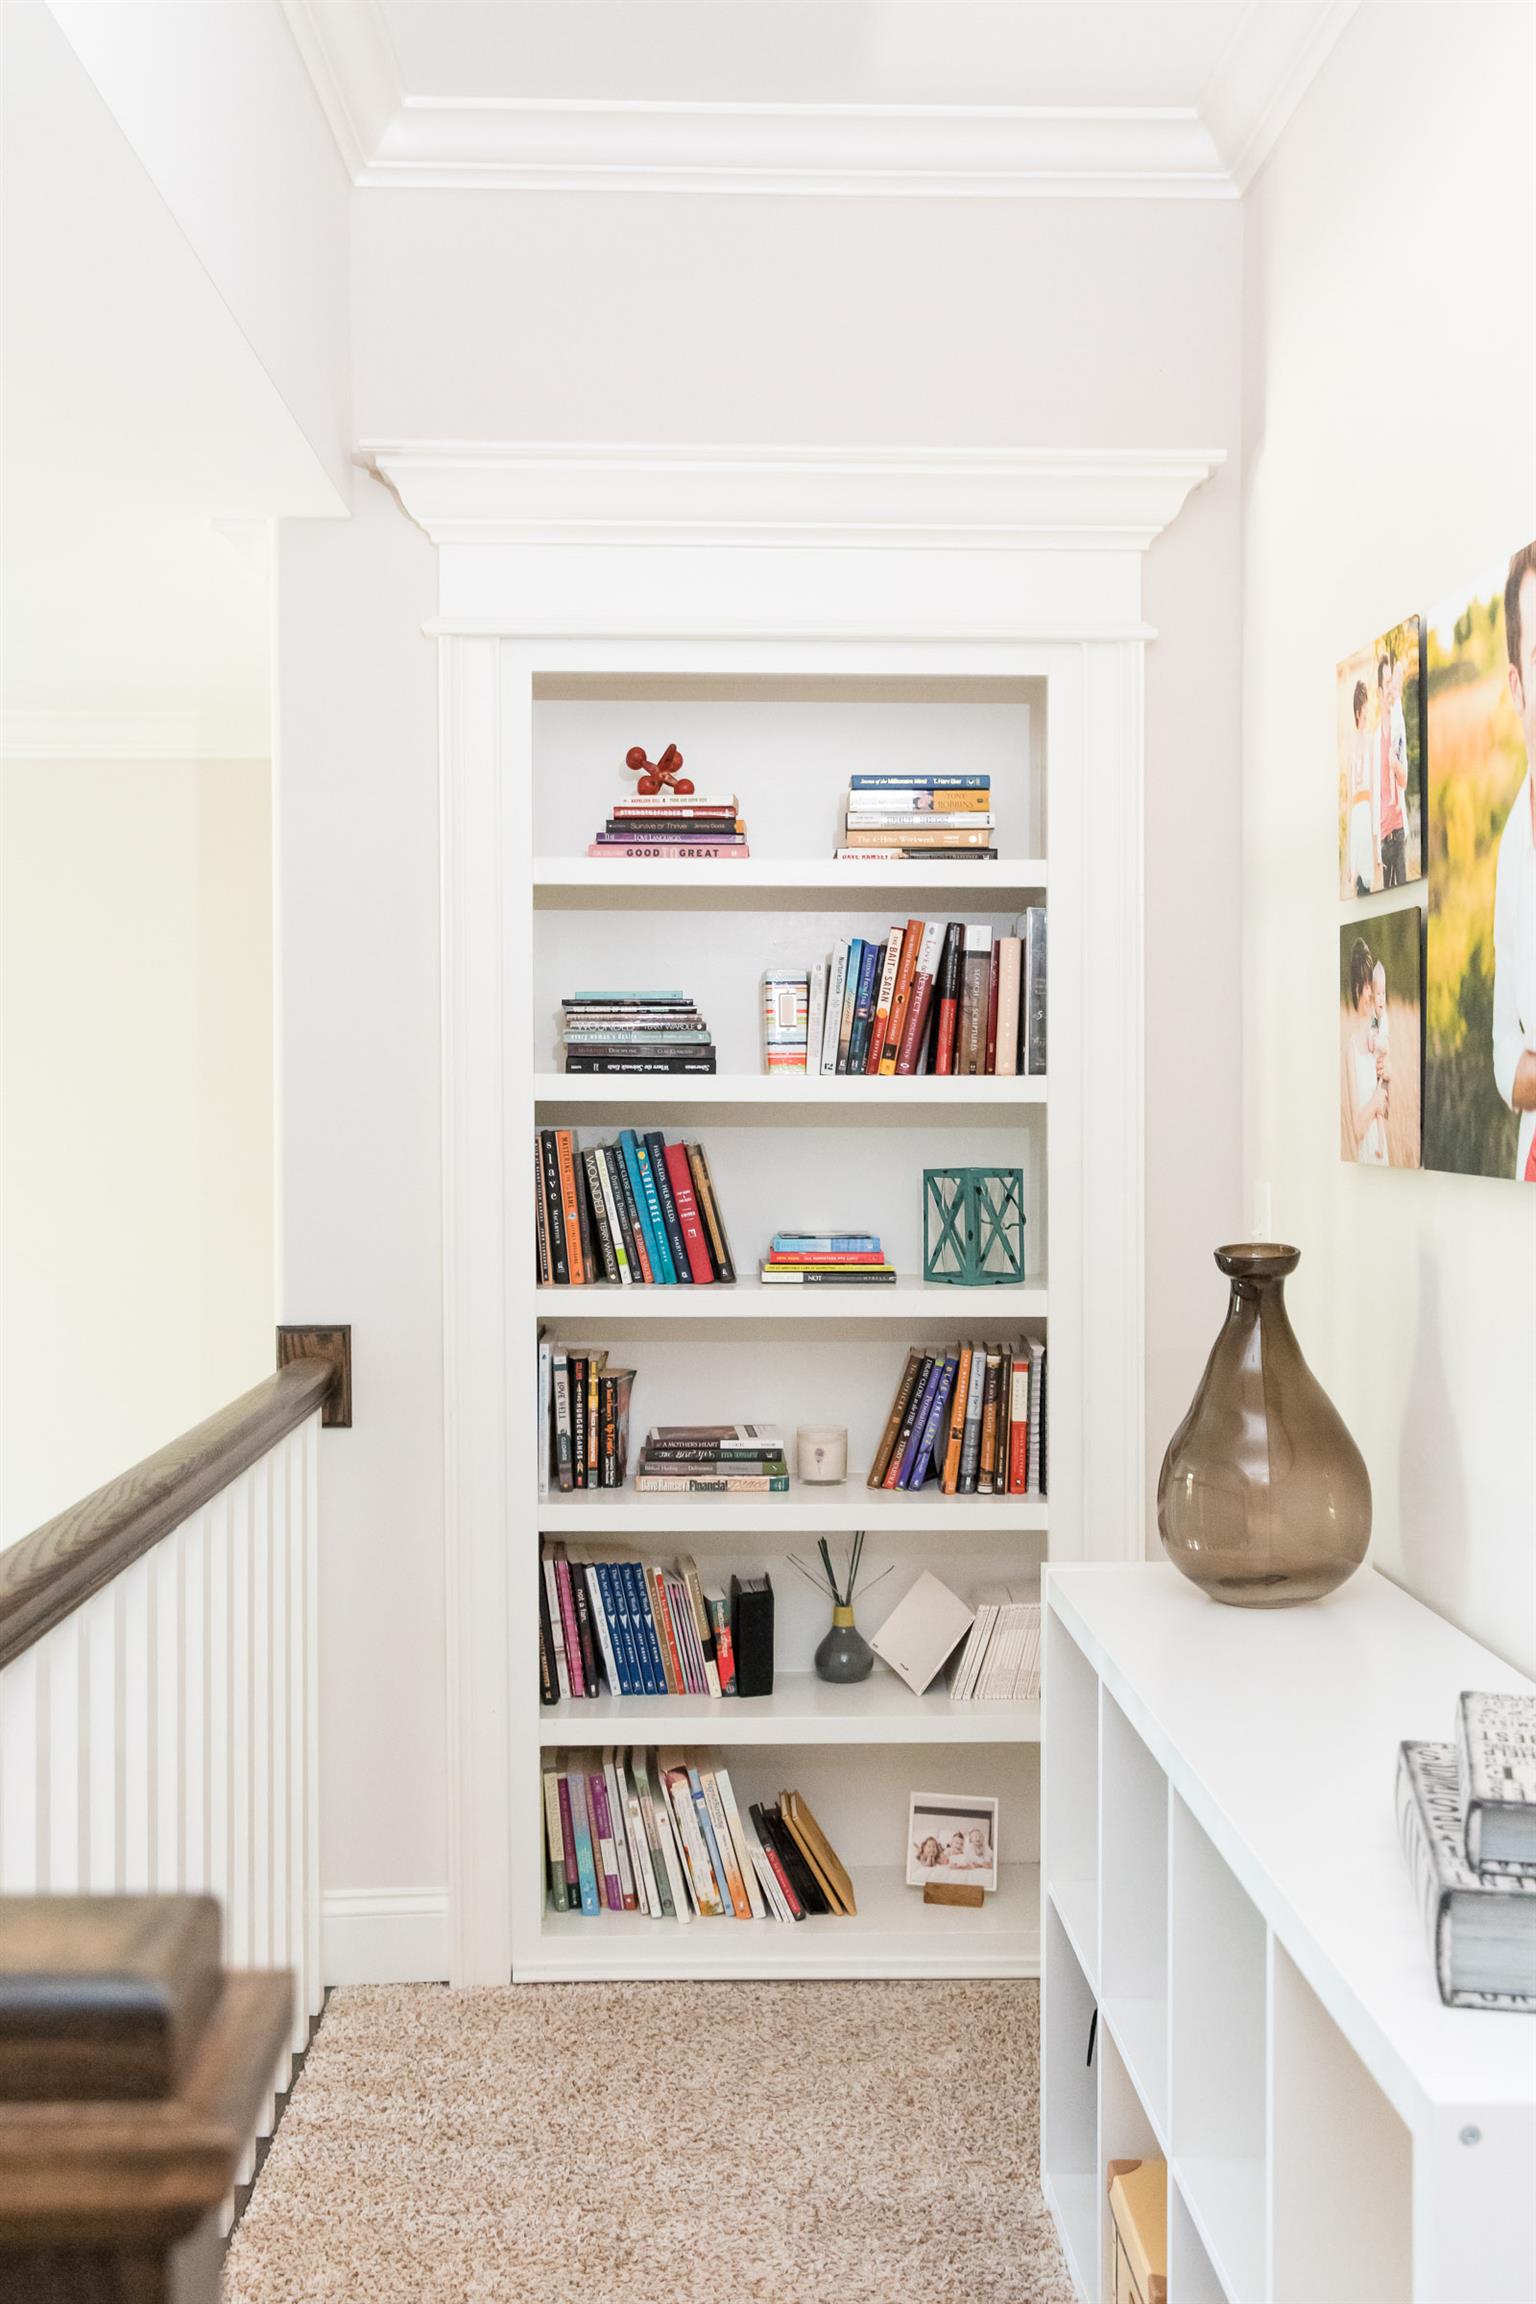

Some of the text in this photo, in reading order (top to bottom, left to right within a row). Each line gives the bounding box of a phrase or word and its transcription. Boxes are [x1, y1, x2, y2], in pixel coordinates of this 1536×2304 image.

[887, 946, 897, 966] BAIT
[923, 939, 935, 966] LOVE
[836, 956, 844, 994] NurtureShock
[881, 975, 893, 1002] SATAN
[913, 971, 929, 1014] RESPECT
[970, 1008, 978, 1051] SCRIPTURES
[562, 1136, 574, 1208] MASTERING GAME
[587, 1155, 605, 1214] WOUNDED
[616, 1150, 625, 1168] DRAW
[621, 1169, 630, 1189] CLOSE
[606, 1151, 614, 1173] VICTORY
[611, 1175, 619, 1190] OVER
[617, 1202, 628, 1230] DARKNESS
[642, 1171, 660, 1222] LOVE DOES
[666, 1200, 675, 1223] NEEDS
[600, 1221, 609, 1241] TERRY
[604, 1242, 615, 1272] WARDLE
[922, 1358, 931, 1378] DRAW
[557, 1381, 565, 1397] LOVE
[897, 1375, 912, 1410] NOTICER
[916, 1377, 926, 1398] CLOSE
[907, 1411, 915, 1425] FIRE
[925, 1365, 953, 1446] BLUE LIKE JAZZ
[887, 1440, 906, 1485] TERRY WARDLE
[689, 1480, 727, 1491] Financial
